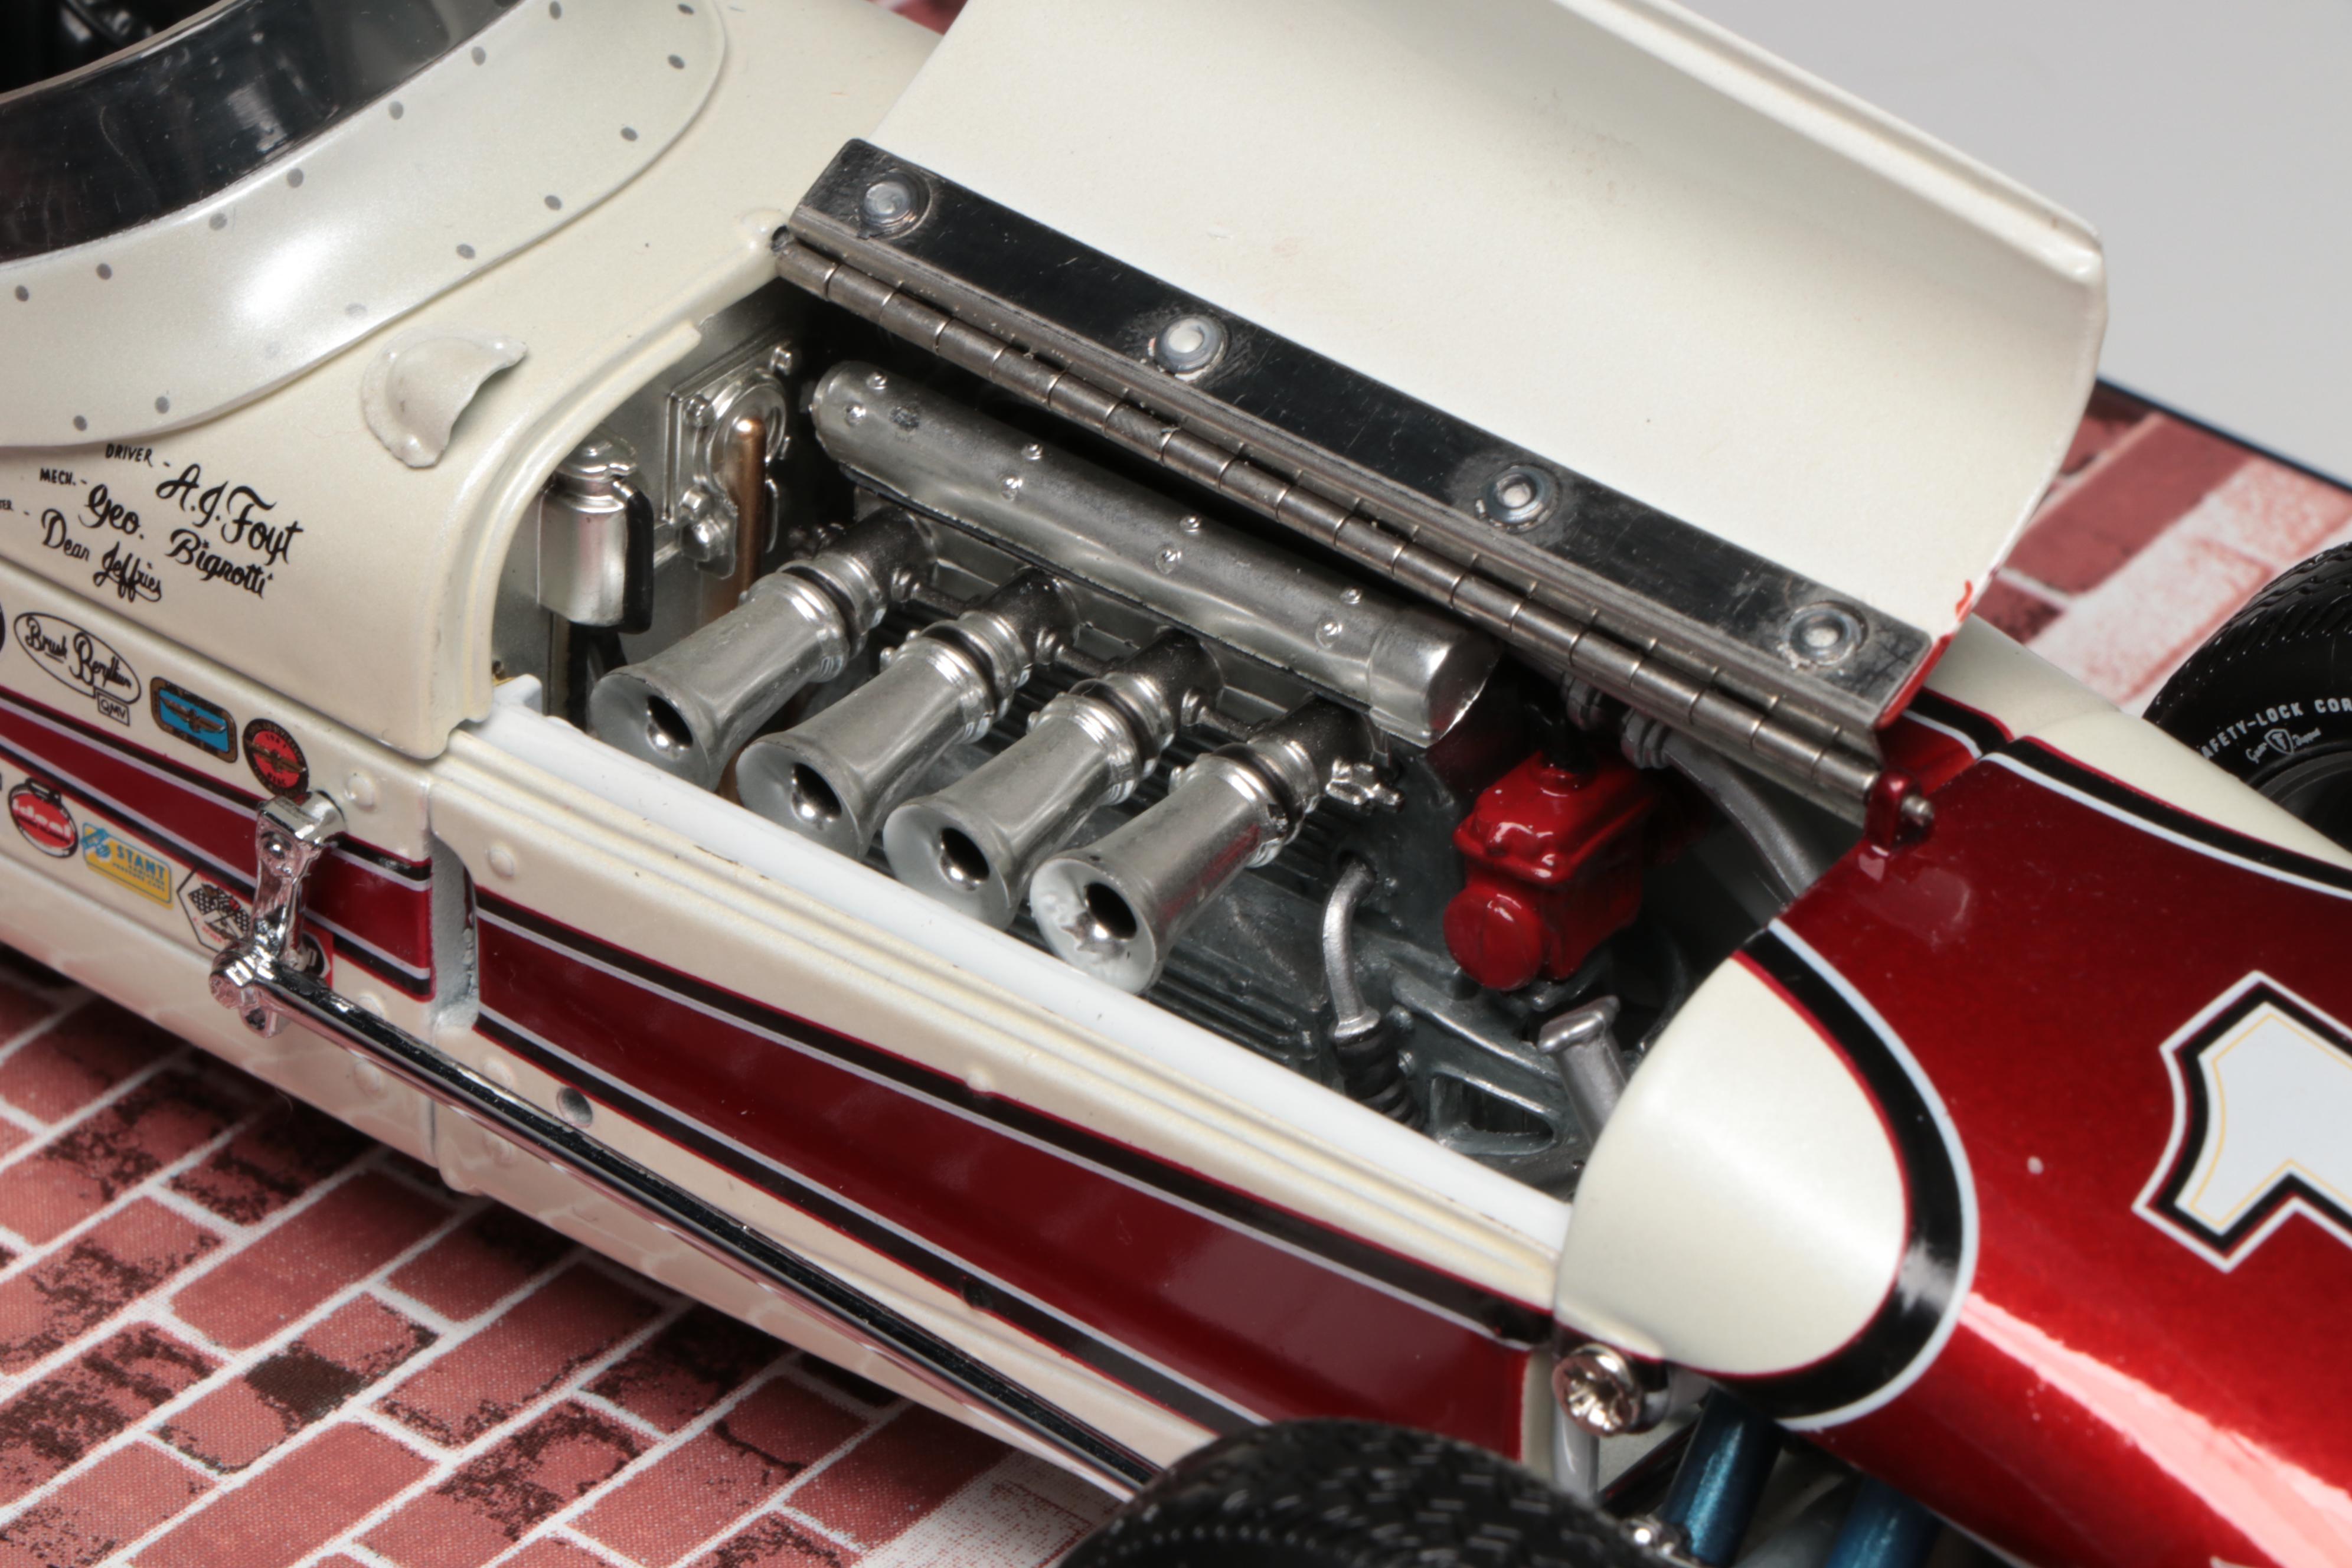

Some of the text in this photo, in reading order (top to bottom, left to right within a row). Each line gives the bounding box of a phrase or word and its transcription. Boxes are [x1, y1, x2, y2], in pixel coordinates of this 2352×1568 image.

[40, 468, 76, 486] MECH.
[78, 484, 144, 540] Geo.
[165, 528, 273, 599] Bignotti
[41, 508, 90, 561] Dean
[93, 541, 162, 602] Jeffries
[106, 443, 153, 466] DRIVER
[221, 485, 303, 566] Foyt
[117, 845, 165, 879] STANT
